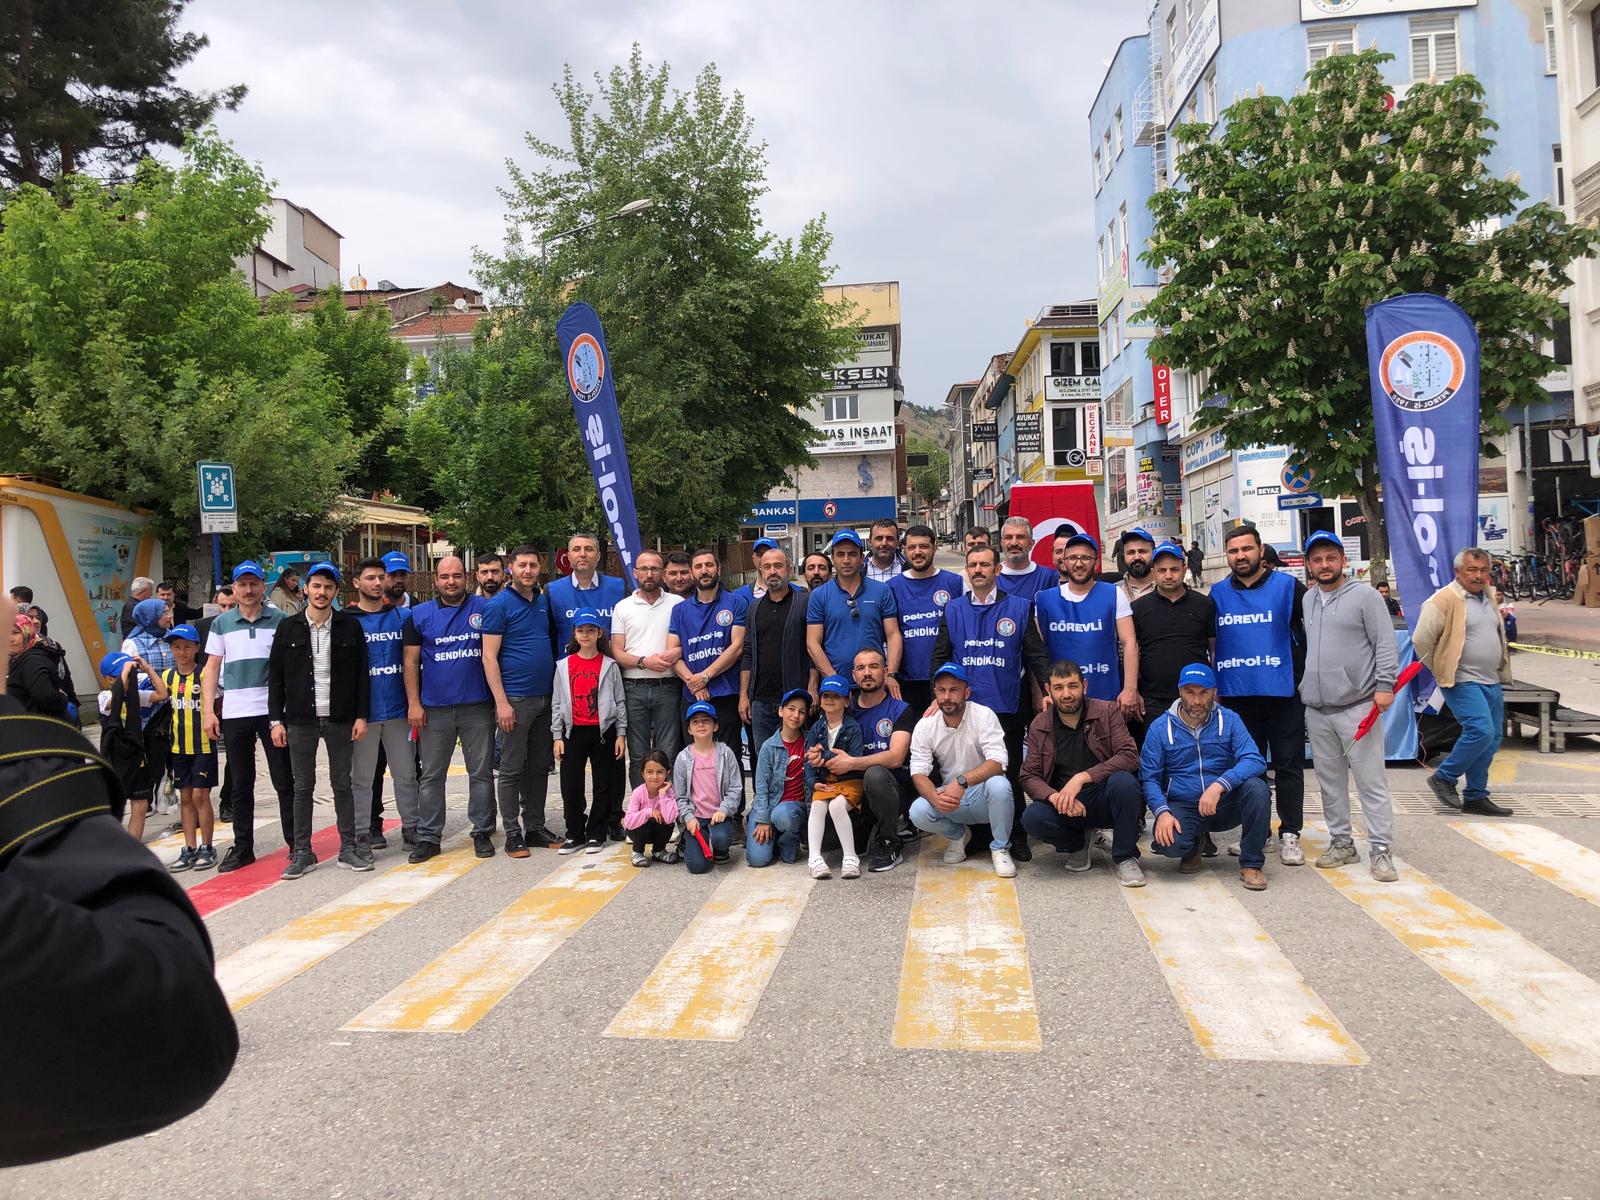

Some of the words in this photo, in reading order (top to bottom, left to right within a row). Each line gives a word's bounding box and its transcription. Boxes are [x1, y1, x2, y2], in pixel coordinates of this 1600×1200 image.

[1157, 369, 1169, 421] OTER
[1016, 414, 1040, 422] AVUKAT
[850, 425, 893, 439] İNŞAAT
[1185, 438, 1205, 458] COPY
[1258, 487, 1280, 495] BEYAZ
[751, 507, 795, 516] BANKAS
[1218, 611, 1273, 626] GÖREVLİ
[1049, 619, 1102, 633] GÖREVLİ
[364, 630, 403, 643] ÖREVLİ
[962, 655, 1006, 668] SENDİKASI
[1217, 655, 1282, 672] petrol-iş
